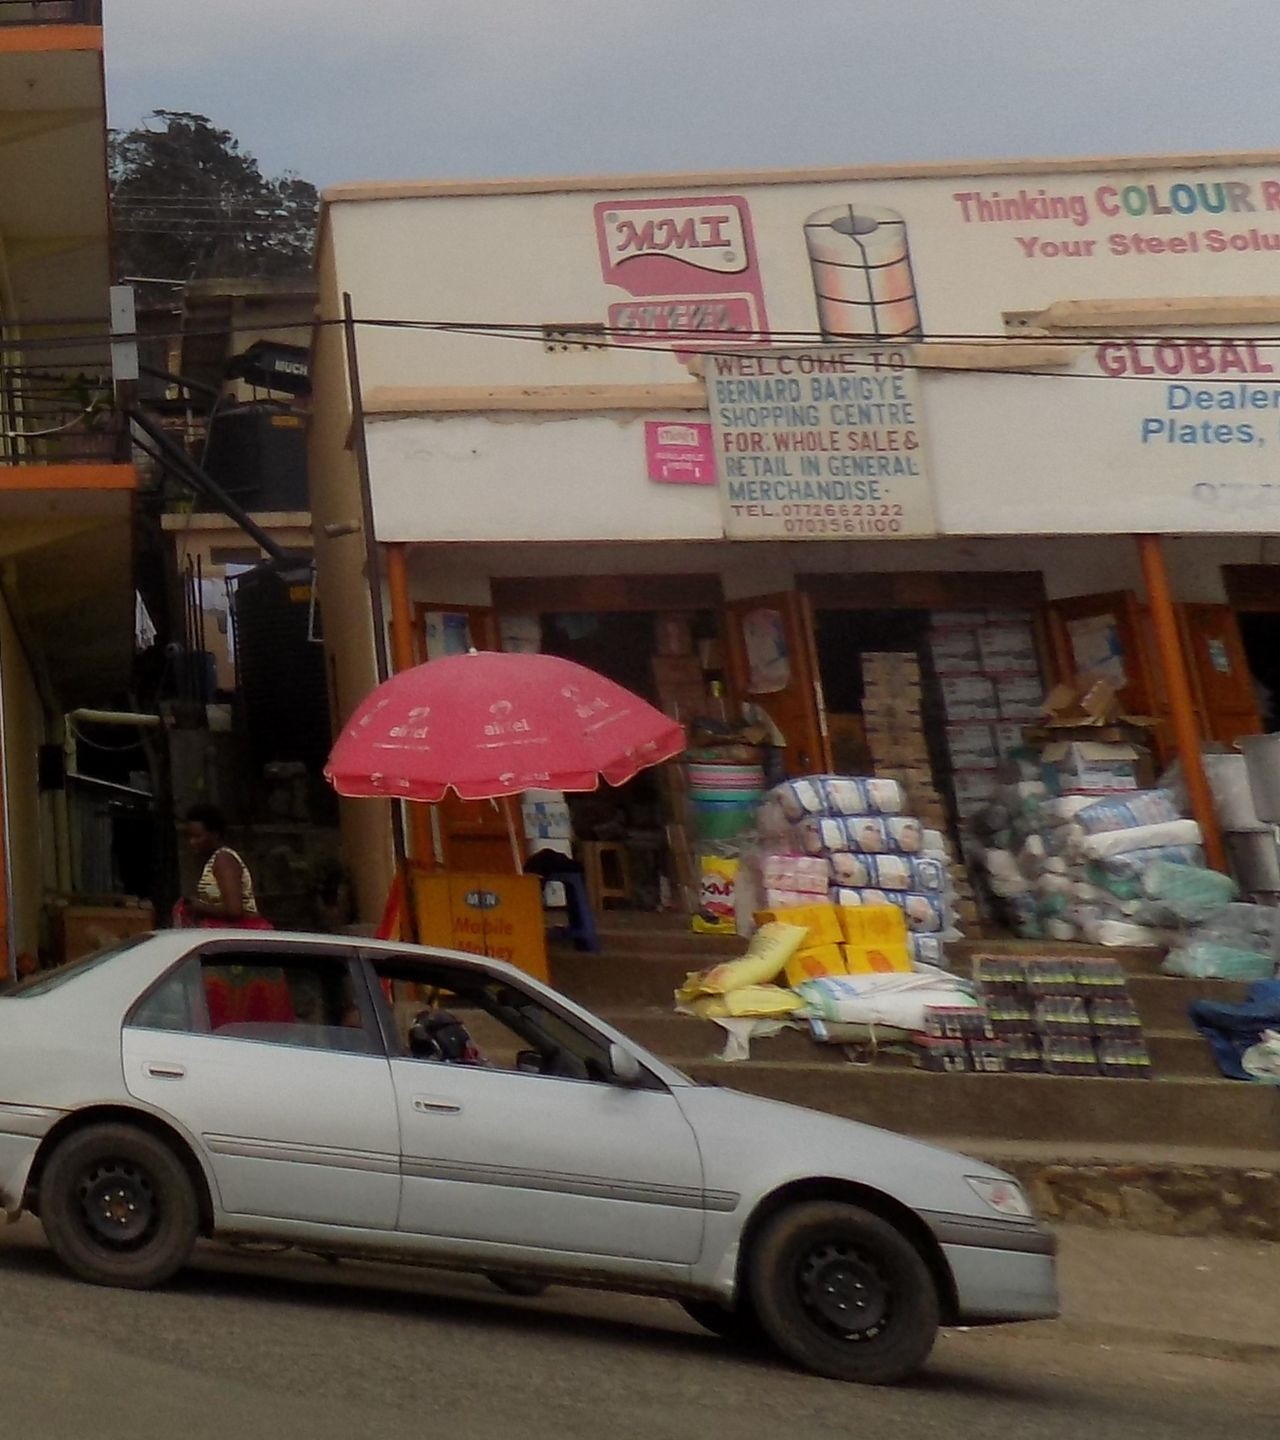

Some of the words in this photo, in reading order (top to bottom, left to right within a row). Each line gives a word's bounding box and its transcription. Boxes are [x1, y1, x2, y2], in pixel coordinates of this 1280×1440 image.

[953, 189, 1089, 227] Thinking
[1095, 182, 1255, 216] COLOUR
[1015, 236, 1097, 258] Your
[1108, 232, 1200, 256] Steel
[714, 353, 857, 376] WELCOME
[869, 352, 906, 373] TO
[1095, 338, 1274, 377] GLOBAL
[716, 378, 801, 404] BERNARD
[812, 375, 906, 402] BARIGYE
[721, 405, 821, 428] SHOPPING
[830, 403, 917, 426] CENTRE
[775, 432, 841, 452] WHOLE
[1141, 418, 1265, 447] Plates,
[725, 456, 793, 477] RETAIL
[801, 457, 821, 476] IN
[467, 893, 496, 905] MN
[455, 917, 513, 935] Mobile
[458, 940, 513, 960] Mney
